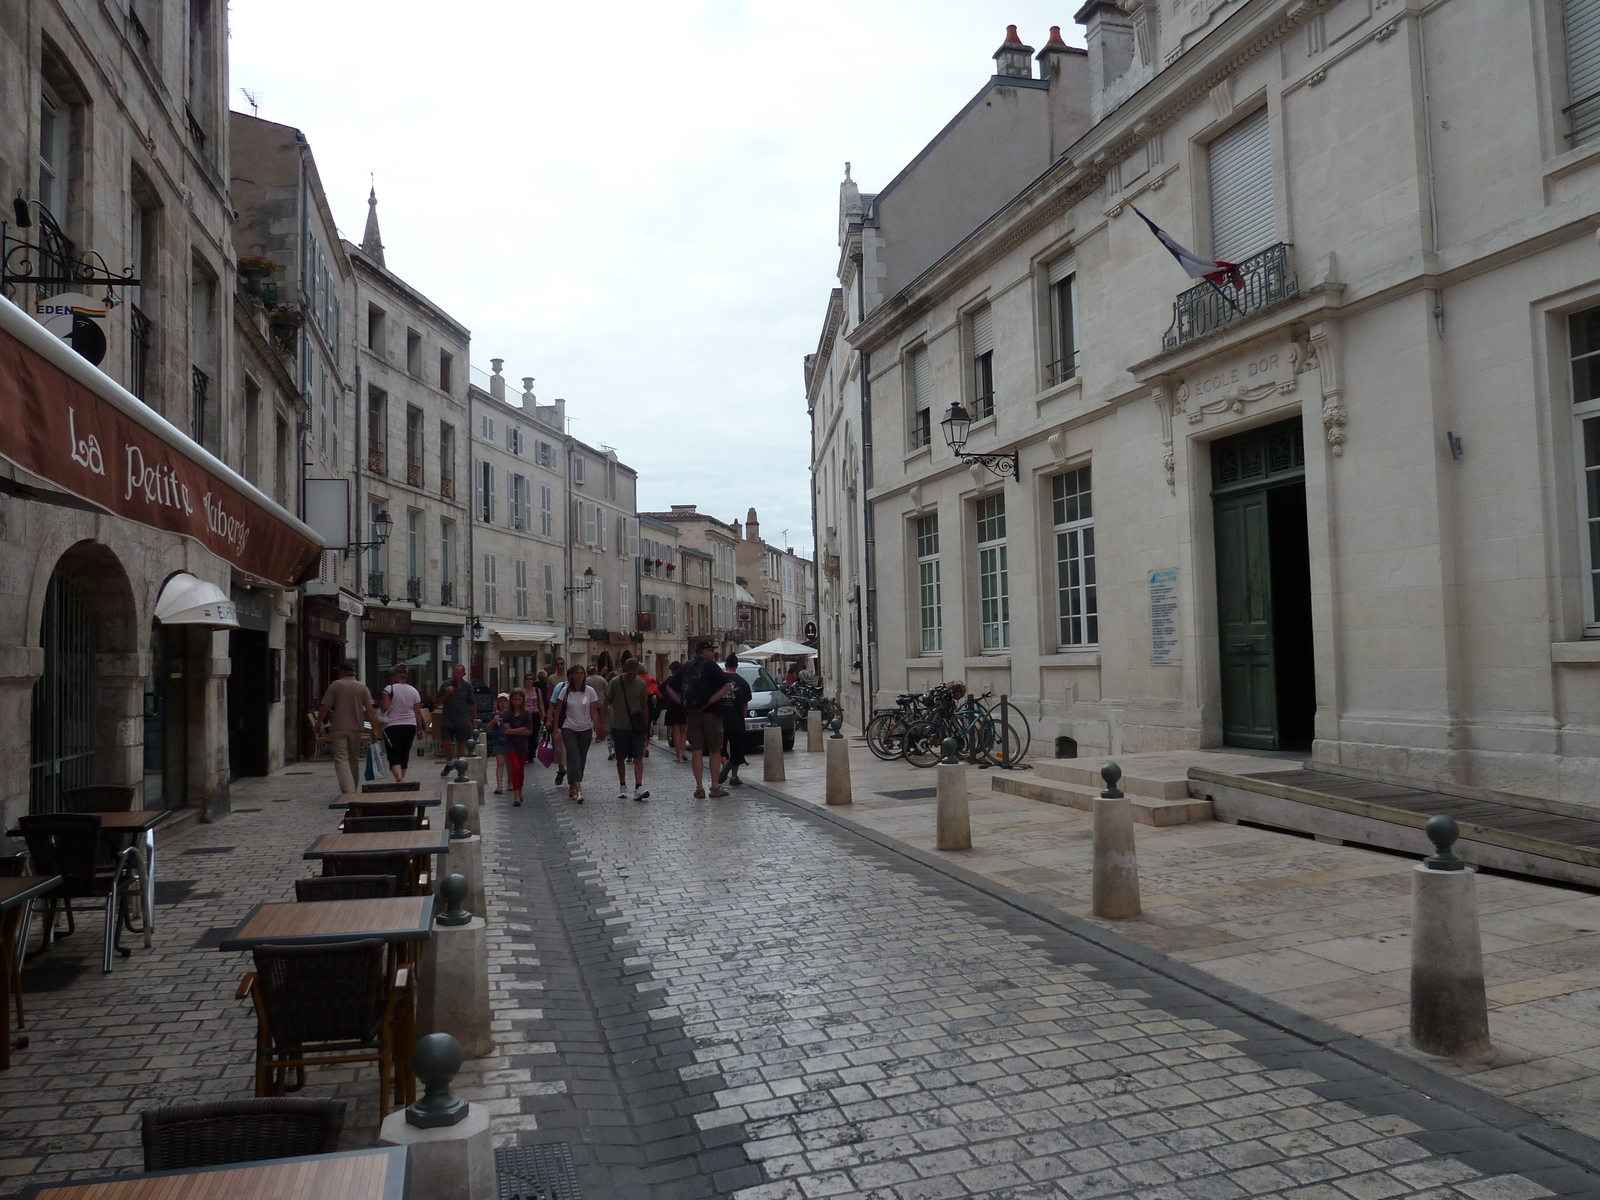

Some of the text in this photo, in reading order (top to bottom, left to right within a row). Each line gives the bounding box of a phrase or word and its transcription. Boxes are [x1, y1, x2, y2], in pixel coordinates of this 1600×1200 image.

[36, 305, 73, 315] EDEN
[1194, 354, 1280, 397] ECOLE DOR
[67, 406, 250, 557] La Petite Auberge
